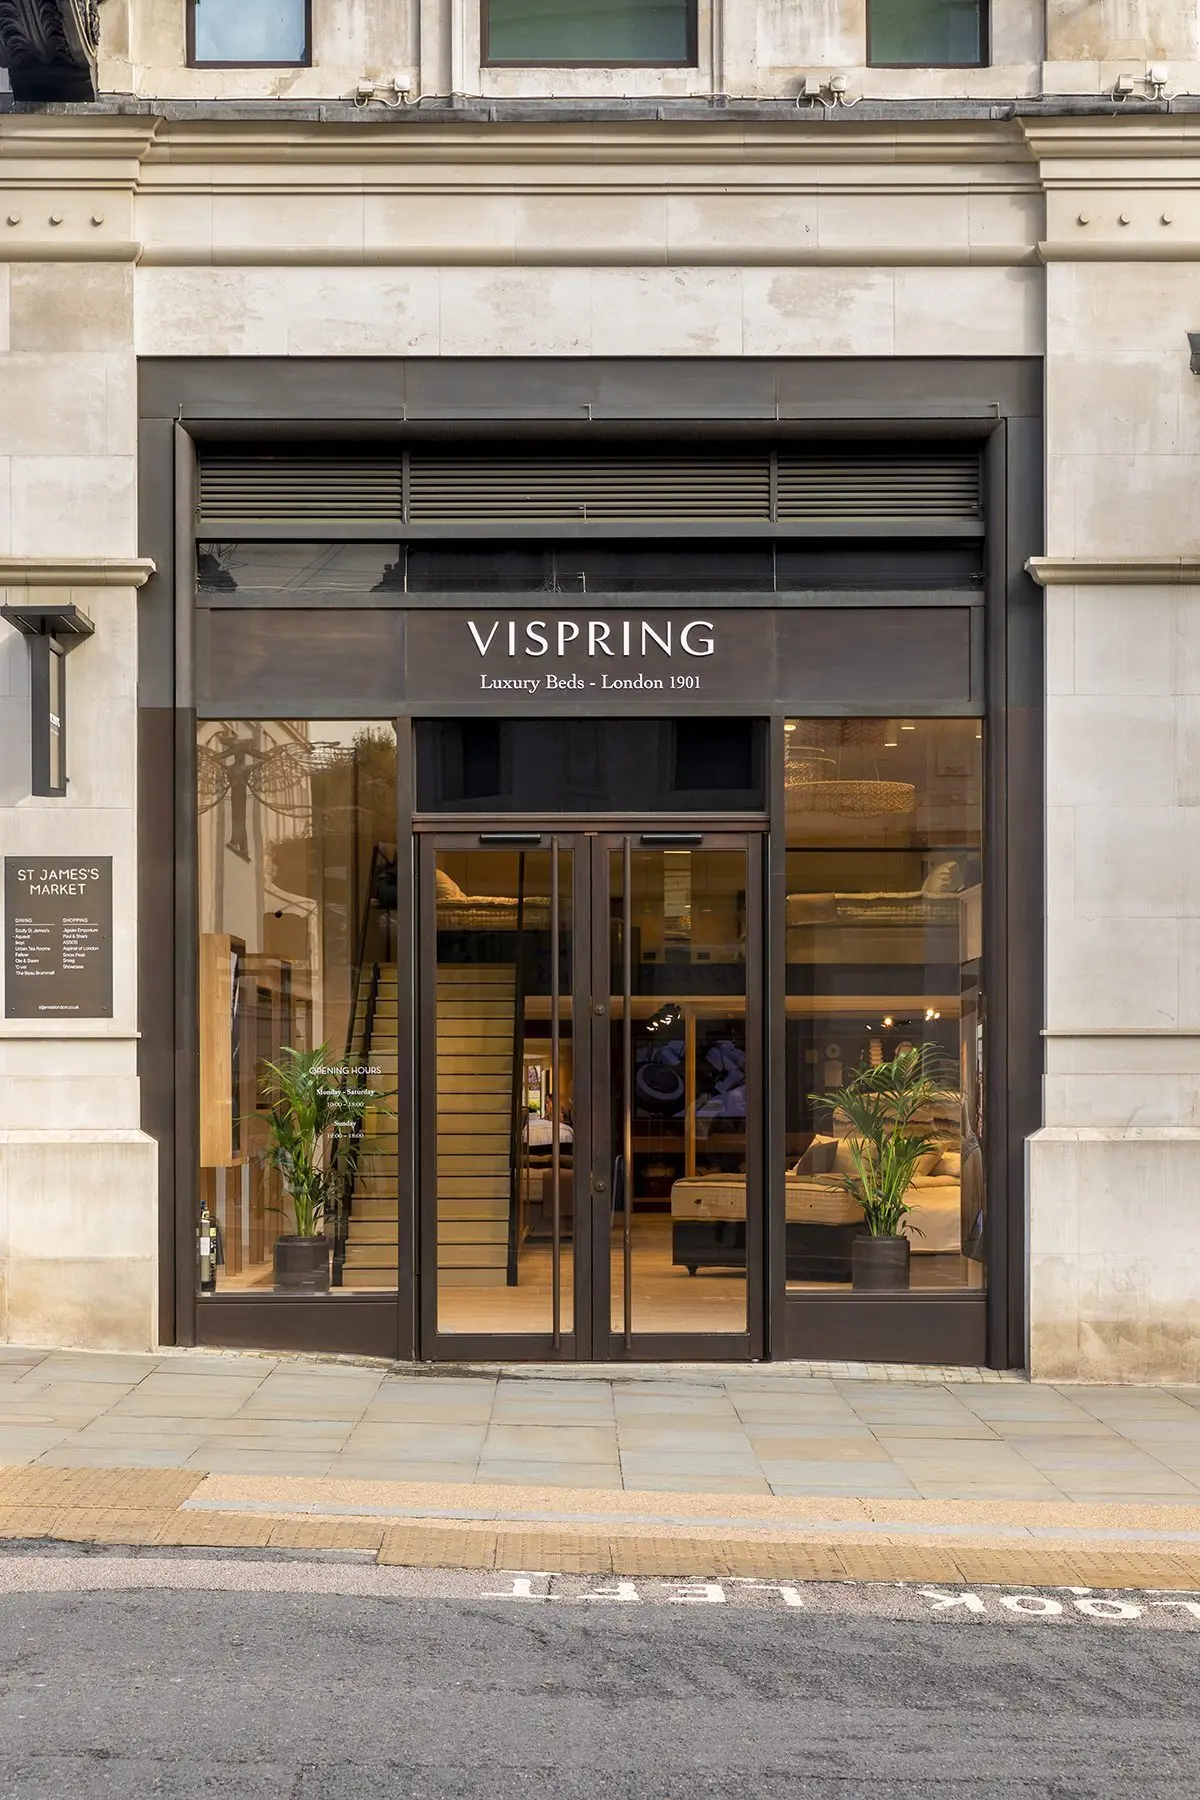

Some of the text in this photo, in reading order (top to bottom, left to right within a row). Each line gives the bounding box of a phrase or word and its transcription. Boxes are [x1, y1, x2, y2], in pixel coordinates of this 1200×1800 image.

[467, 620, 715, 657] VISPRING
[480, 674, 541, 694] Luxury
[545, 674, 585, 690] Beds
[601, 674, 664, 690] London
[669, 675, 701, 690] 1901
[17, 868, 100, 881] ST JAMES'S
[29, 883, 86, 895] MARKET
[309, 1066, 382, 1075] OPENING HOURS
[480, 1578, 804, 1607] LEFT
